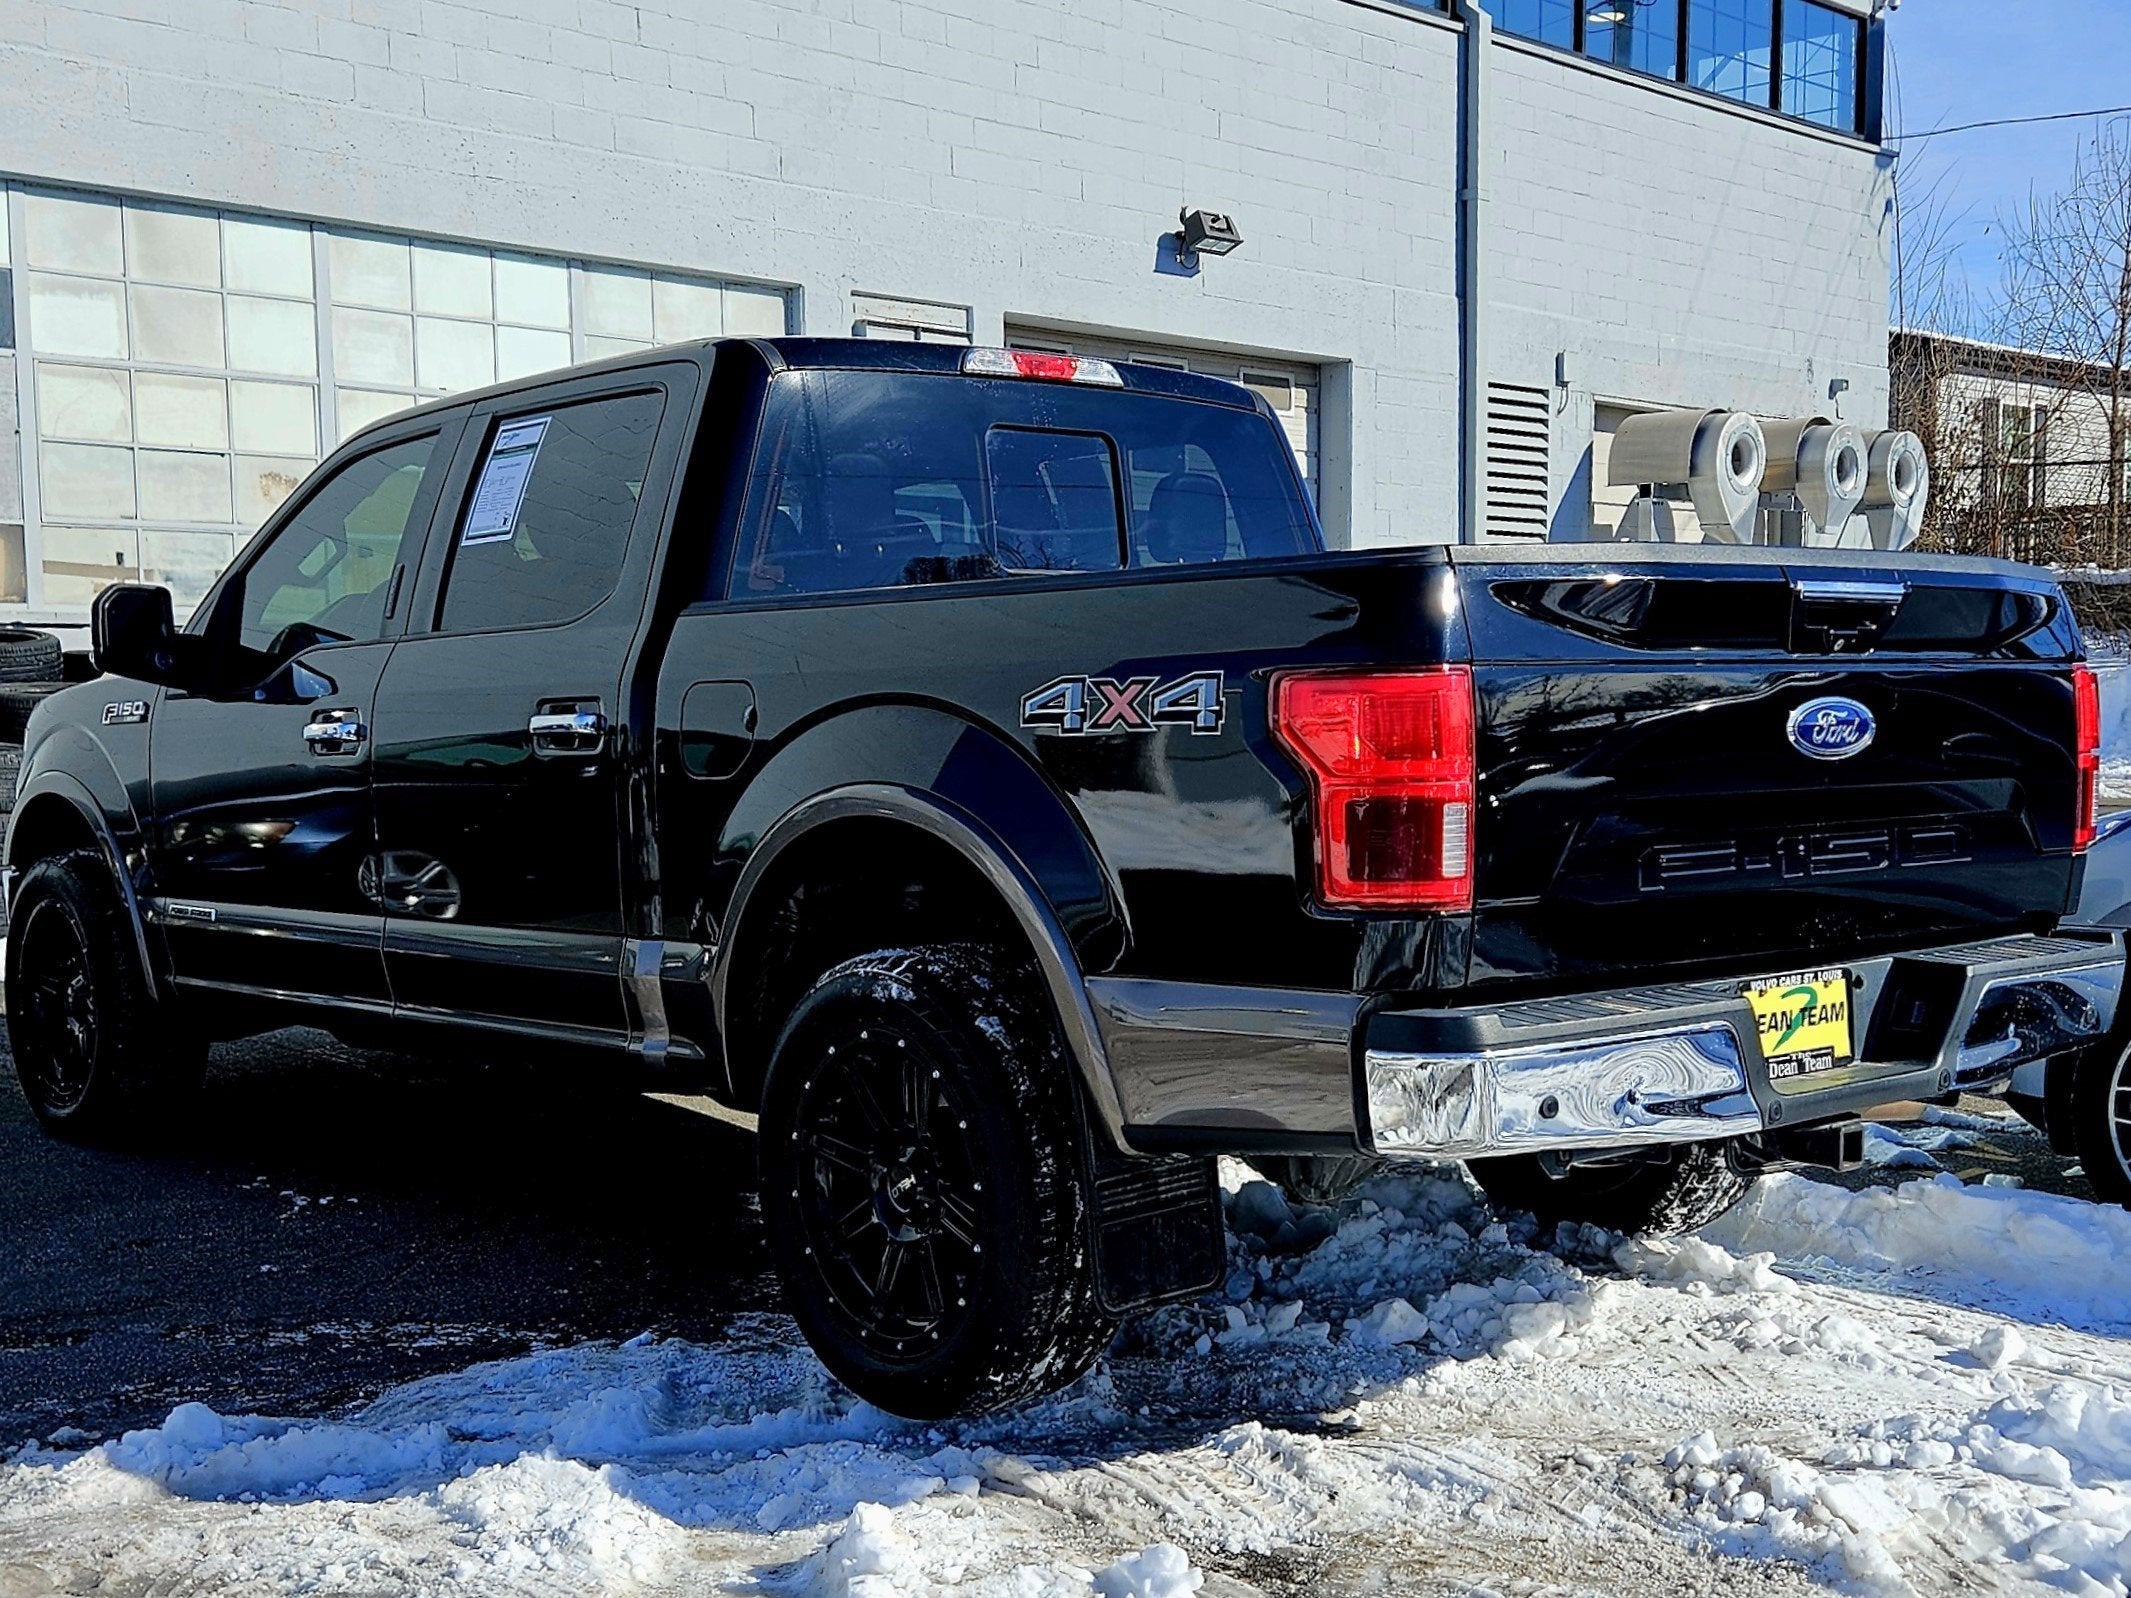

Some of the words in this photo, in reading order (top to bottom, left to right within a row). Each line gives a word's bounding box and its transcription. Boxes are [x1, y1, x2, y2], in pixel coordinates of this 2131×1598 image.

[1812, 709, 1860, 744] Ford
[1638, 824, 1972, 892] F-150
[1751, 978, 1778, 991] VOLVO
[1779, 974, 1801, 986] CARS
[1804, 972, 1816, 984] ST.
[1818, 969, 1843, 980] LOUIS
[1757, 1011, 1792, 1034] EAN
[1801, 1002, 1844, 1027] TEAM
[1769, 1061, 1799, 1078] Dean
[1803, 1054, 1832, 1072] Team
